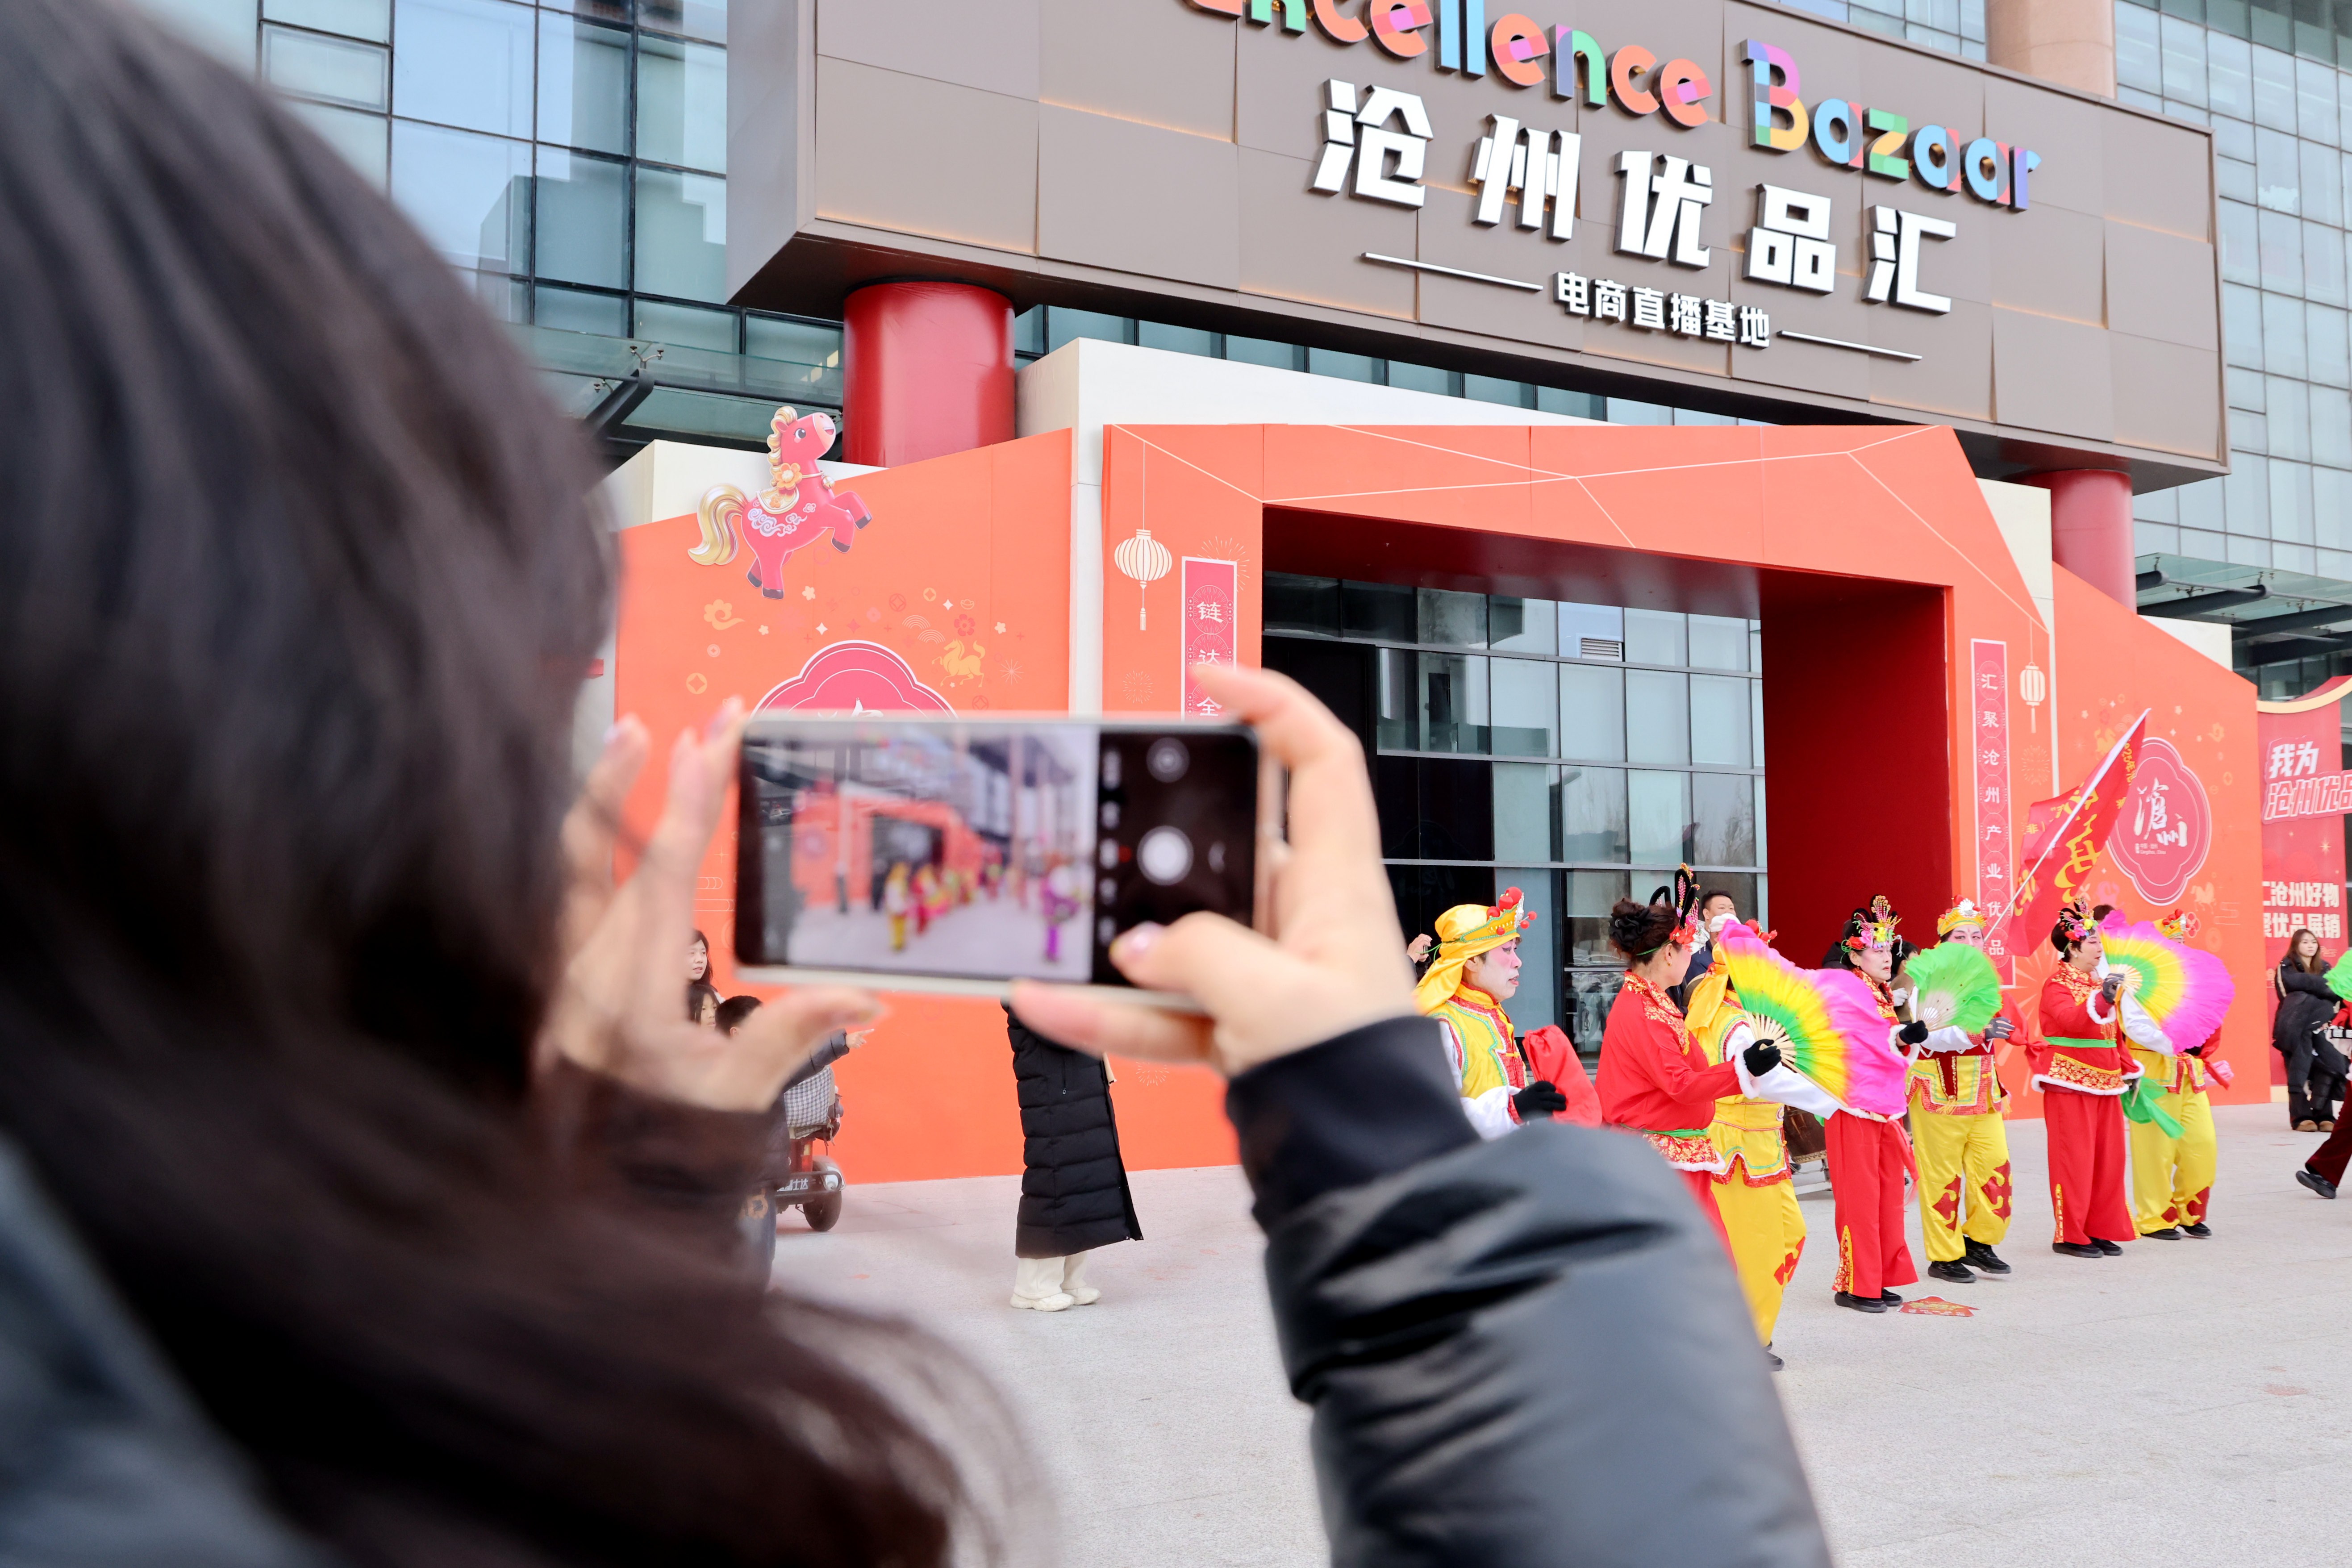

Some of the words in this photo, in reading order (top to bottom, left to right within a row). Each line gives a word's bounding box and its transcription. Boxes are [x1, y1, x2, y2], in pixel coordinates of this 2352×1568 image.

[1185, 0, 1713, 127] cellence
[1740, 38, 2042, 211] Bazaar
[1310, 78, 1956, 313] 沧州优品汇
[1555, 271, 1770, 349] 电商直播基地
[1981, 673, 2005, 955] 汇聚沧州产业优品
[2269, 741, 2319, 779] 我为
